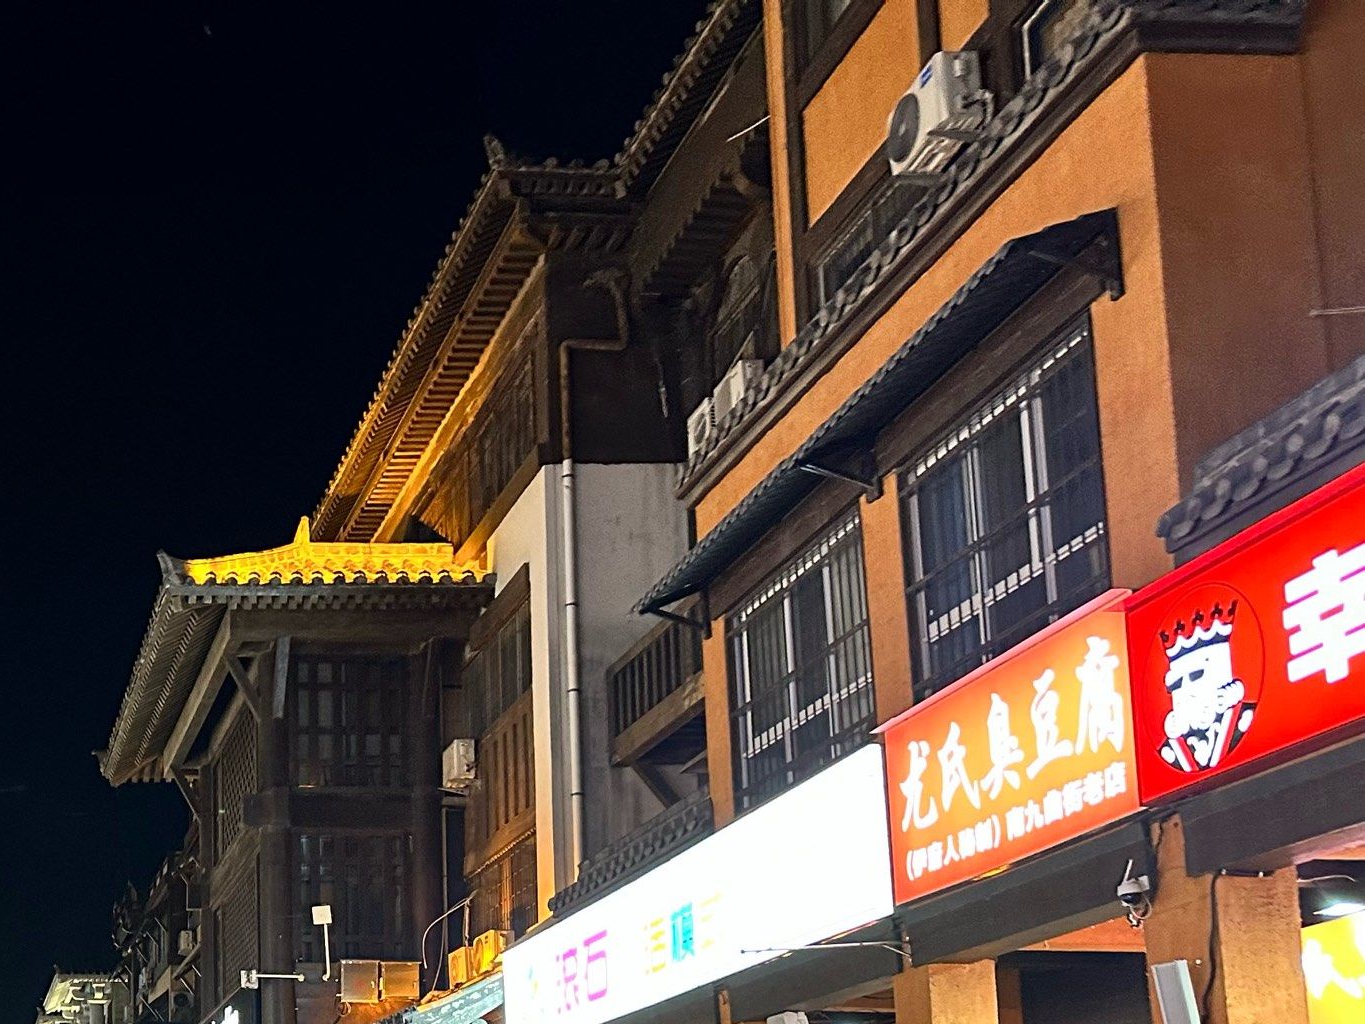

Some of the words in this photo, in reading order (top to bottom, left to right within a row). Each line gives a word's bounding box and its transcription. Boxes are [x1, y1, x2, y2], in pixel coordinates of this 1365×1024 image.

[899, 636, 1124, 832] 尤氏臭豆腐
